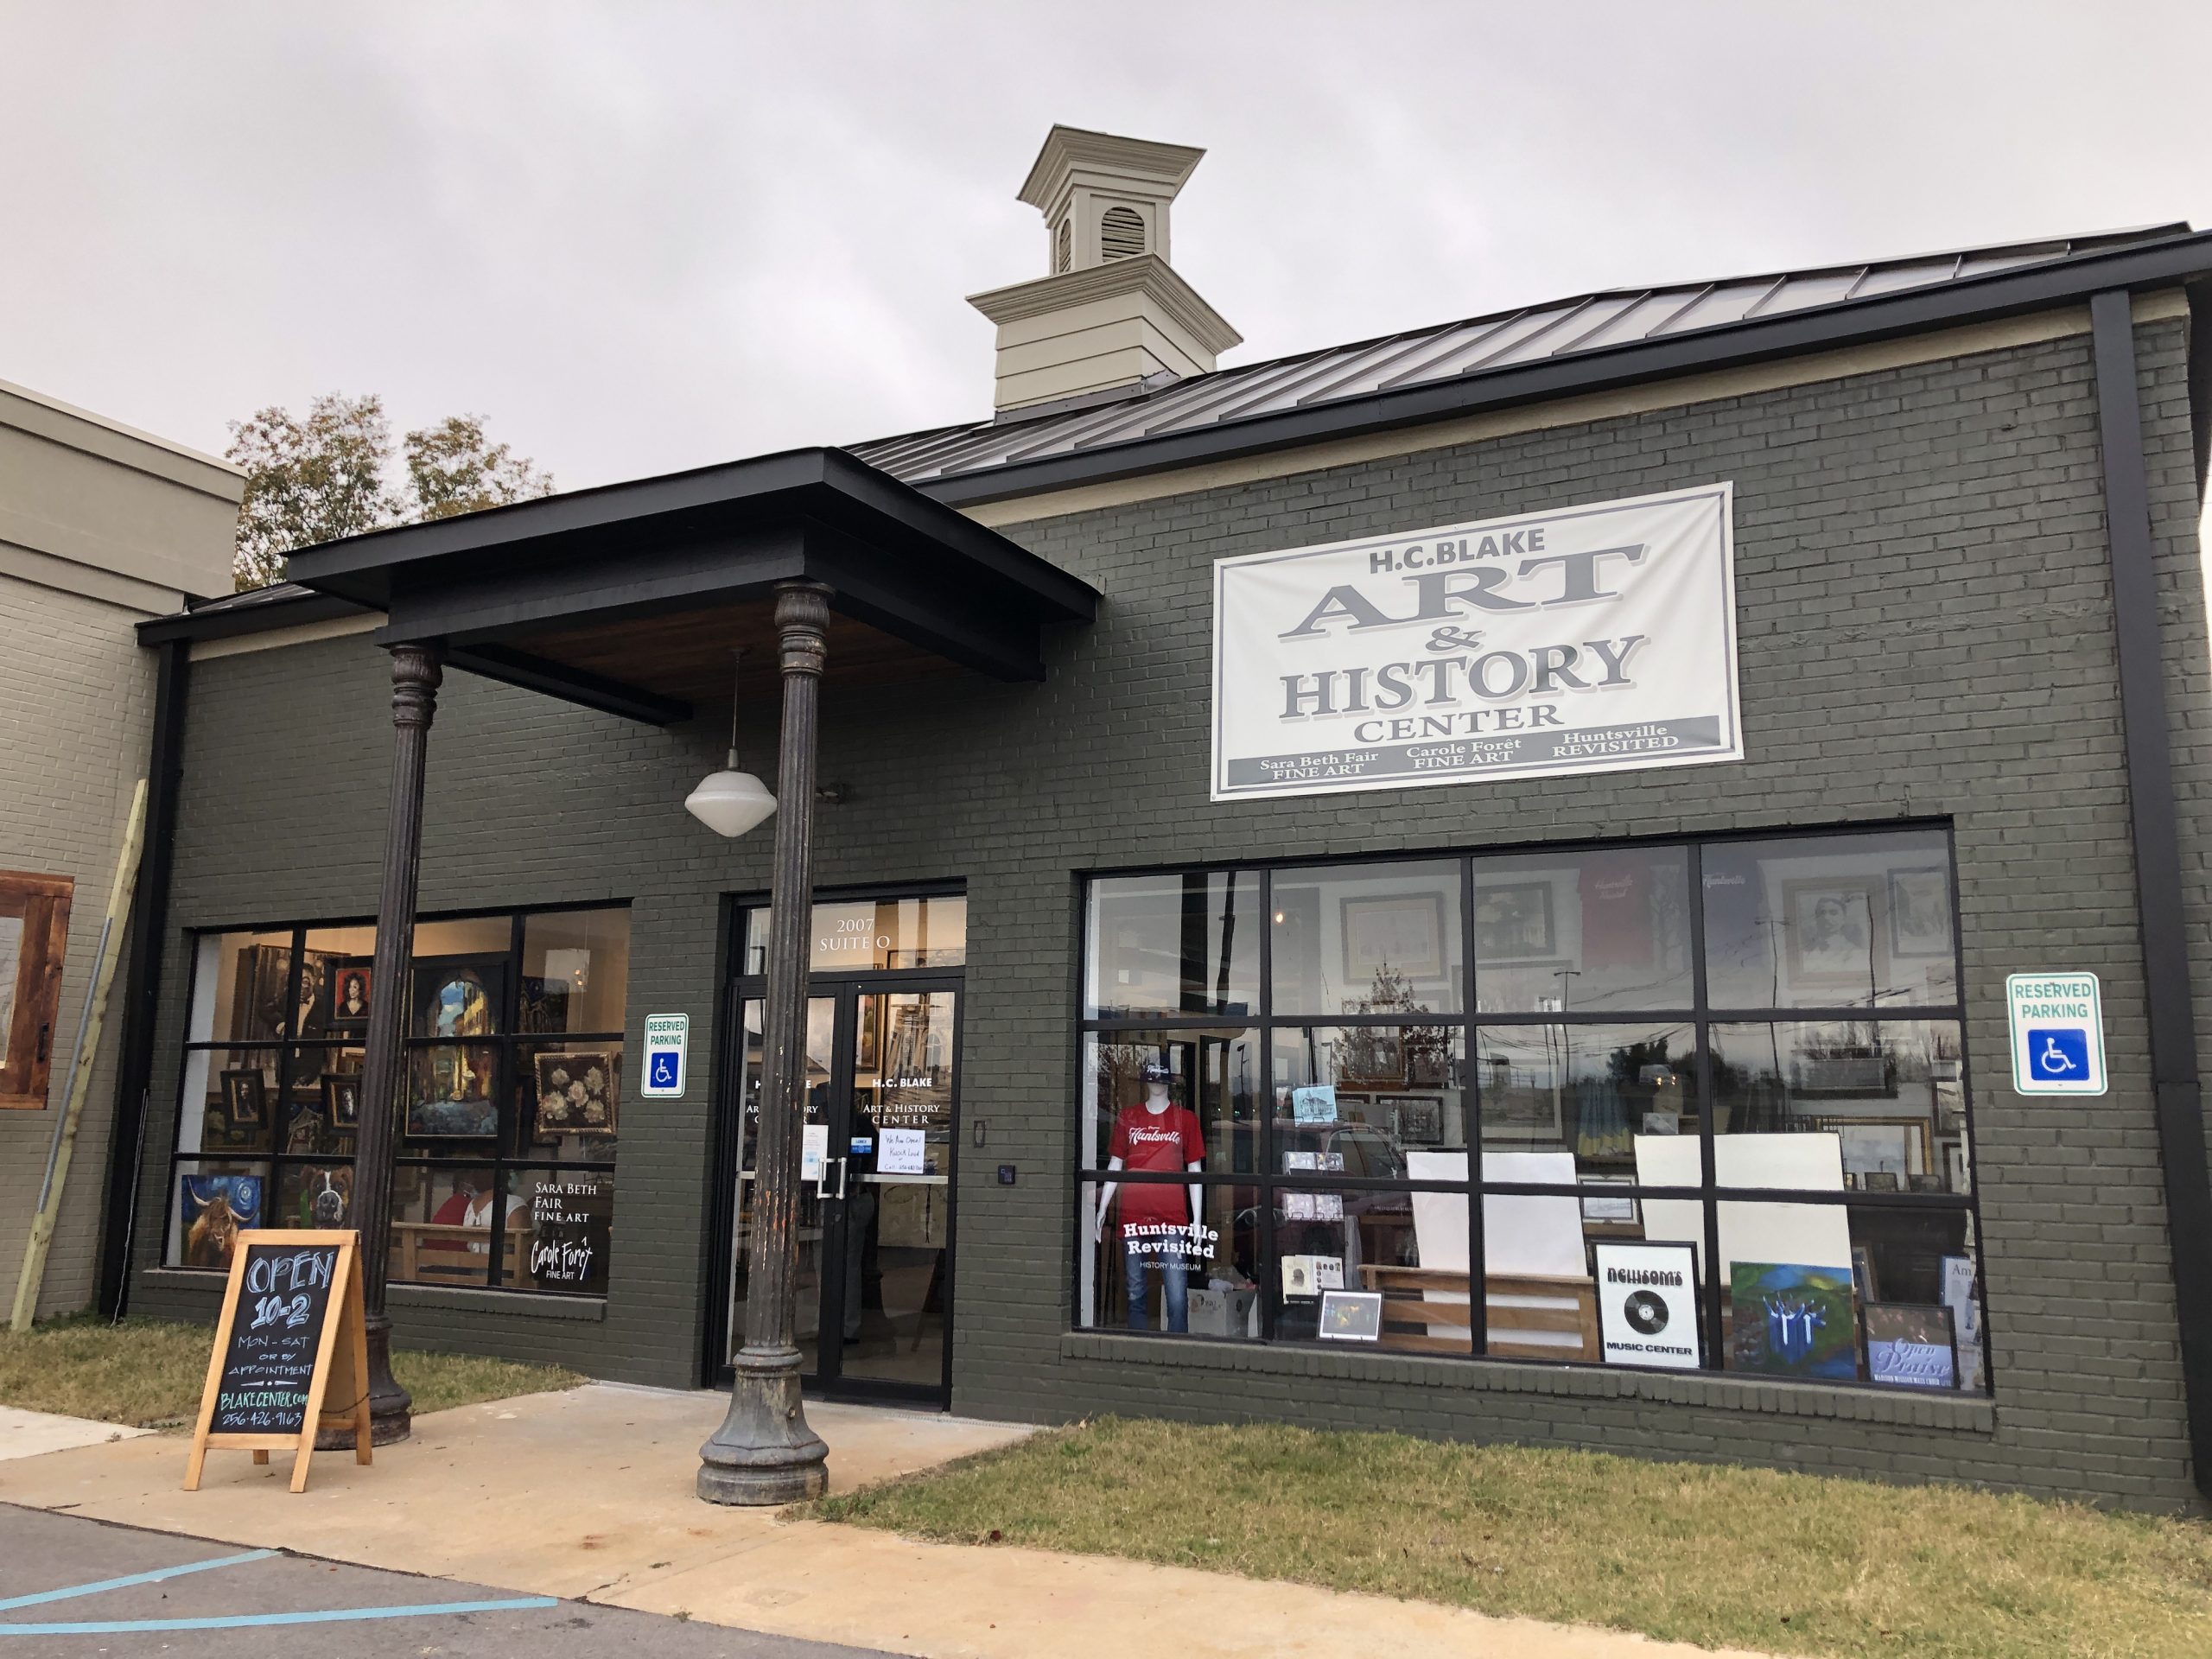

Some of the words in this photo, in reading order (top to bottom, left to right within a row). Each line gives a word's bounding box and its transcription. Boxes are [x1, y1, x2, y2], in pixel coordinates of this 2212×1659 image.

[1278, 543, 1649, 639] ART
[1425, 626, 1483, 652] &
[1279, 634, 1648, 722] HISTORY
[1353, 704, 1564, 743] CENTER
[1563, 724, 1669, 745] Huntsville
[1406, 742, 1466, 758] Carole
[1471, 737, 1522, 752] Forêt
[1552, 736, 1680, 759] REVISITED
[1260, 759, 1297, 771] Sara
[1300, 753, 1338, 767] Beth
[1344, 751, 1379, 765] Fair
[1413, 756, 1465, 769] FINE
[1469, 750, 1514, 765] ART
[1272, 767, 1321, 780] FINE
[1325, 763, 1364, 776] ART
[836, 918, 874, 933] 2007
[820, 937, 870, 951] SUITE
[2015, 983, 2091, 998] RESERVED
[2022, 1003, 2088, 1019] PARKING
[649, 1020, 684, 1032] RESERVED
[651, 1035, 682, 1045] PARKING
[872, 1078, 898, 1088] H.C.
[900, 1077, 932, 1087] BLAKE
[863, 1104, 883, 1113] ART
[894, 1103, 940, 1113] HISTORY
[872, 1116, 929, 1124] CENTER
[1129, 1127, 1180, 1146] Huntsville
[536, 1182, 563, 1193] SARA
[567, 1183, 597, 1195] BETH
[536, 1196, 563, 1209] FAIR
[534, 1211, 562, 1222] FINE
[566, 1213, 589, 1223] ART
[1123, 1222, 1218, 1241] Huntsville
[531, 1239, 560, 1274] Carole
[1127, 1239, 1215, 1259] Revisited
[246, 1250, 334, 1293] OPEN
[1169, 1262, 1201, 1271] MUSEUM
[546, 1270, 561, 1279] FINE
[562, 1271, 575, 1280] ART
[251, 1293, 311, 1329] 10-2
[238, 1335, 268, 1350] MON
[282, 1336, 309, 1348] SAT
[1606, 1342, 1643, 1351] MUSIC
[1645, 1344, 1693, 1355] CENTER
[228, 1363, 313, 1376] APPOINTMENT
